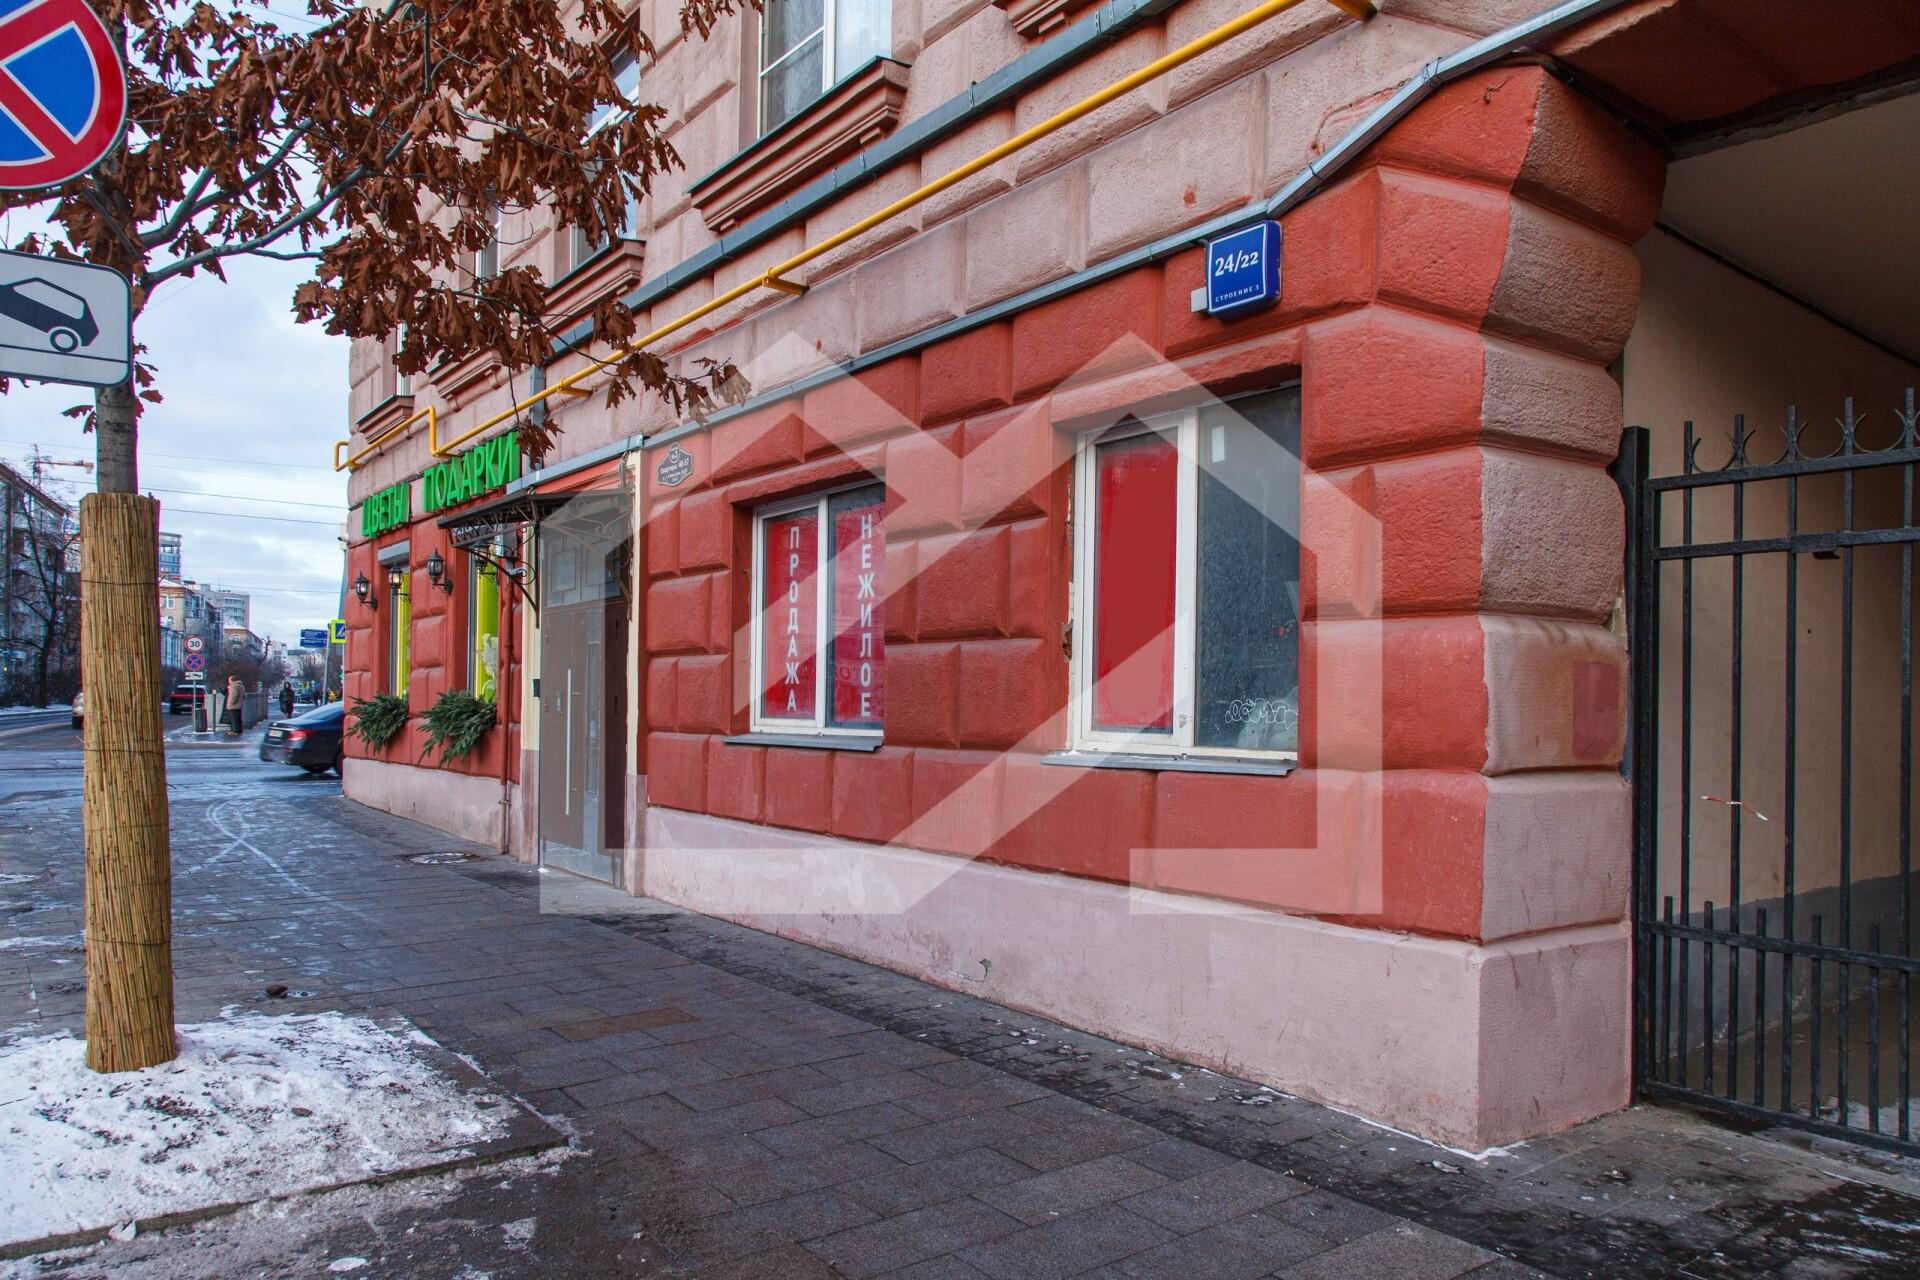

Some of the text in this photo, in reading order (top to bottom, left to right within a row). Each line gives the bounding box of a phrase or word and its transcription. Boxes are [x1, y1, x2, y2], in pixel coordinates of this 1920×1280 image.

[1214, 249, 1259, 277] 24/22
[1215, 286, 1253, 303] СТРОЕНИЕ
[361, 431, 520, 539] ЦВЕТЫ ПОДАРКИ
[189, 640, 201, 648] 30
[784, 525, 800, 713] ПРОДАЖА
[857, 513, 876, 718] НЕЖИЛОЕ
